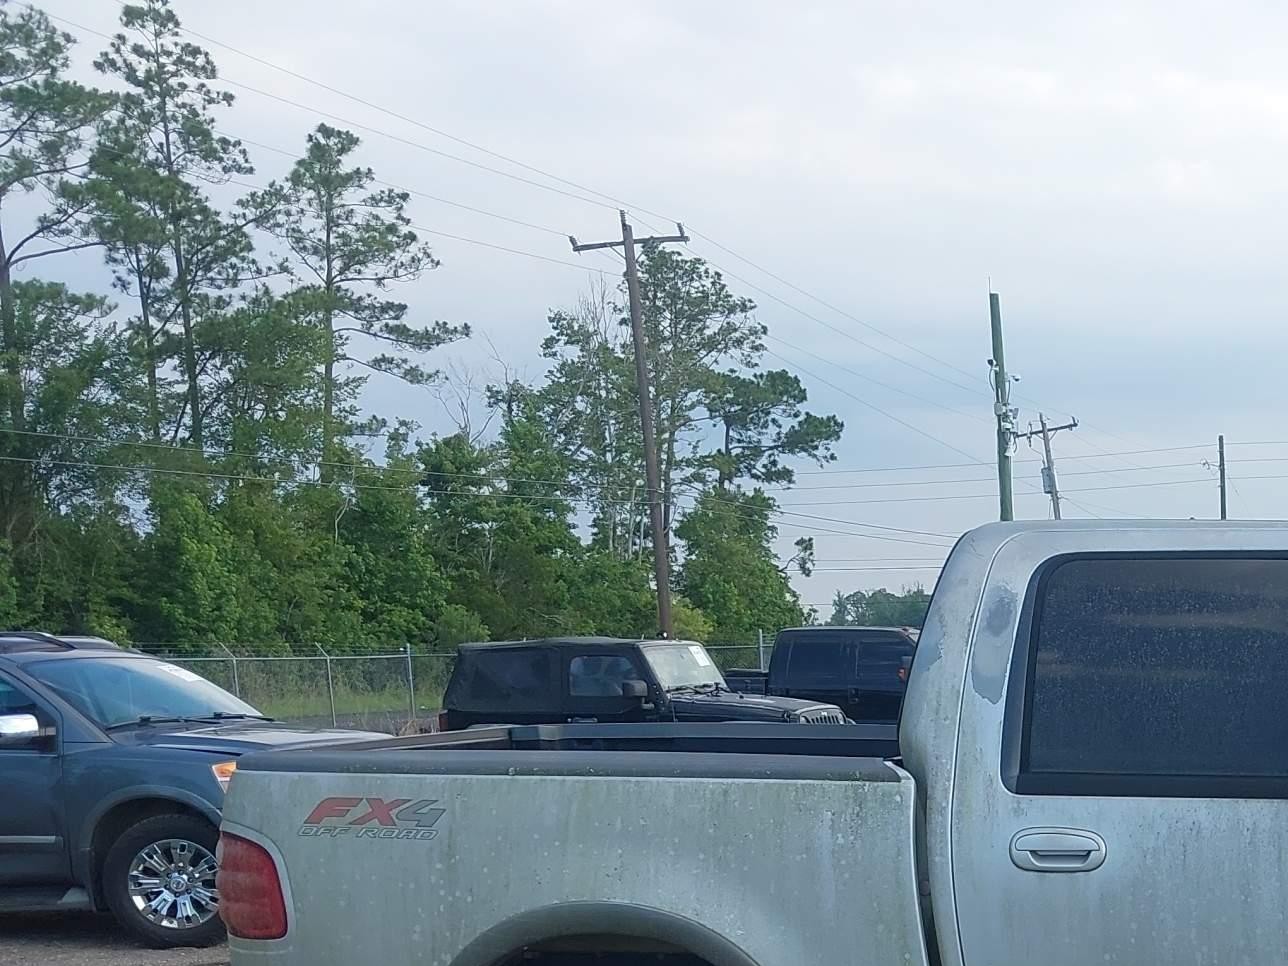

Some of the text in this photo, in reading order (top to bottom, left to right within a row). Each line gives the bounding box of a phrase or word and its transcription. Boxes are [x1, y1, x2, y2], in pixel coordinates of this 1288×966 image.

[304, 797, 446, 828] FX4
[298, 826, 439, 841] OFF ROAD
